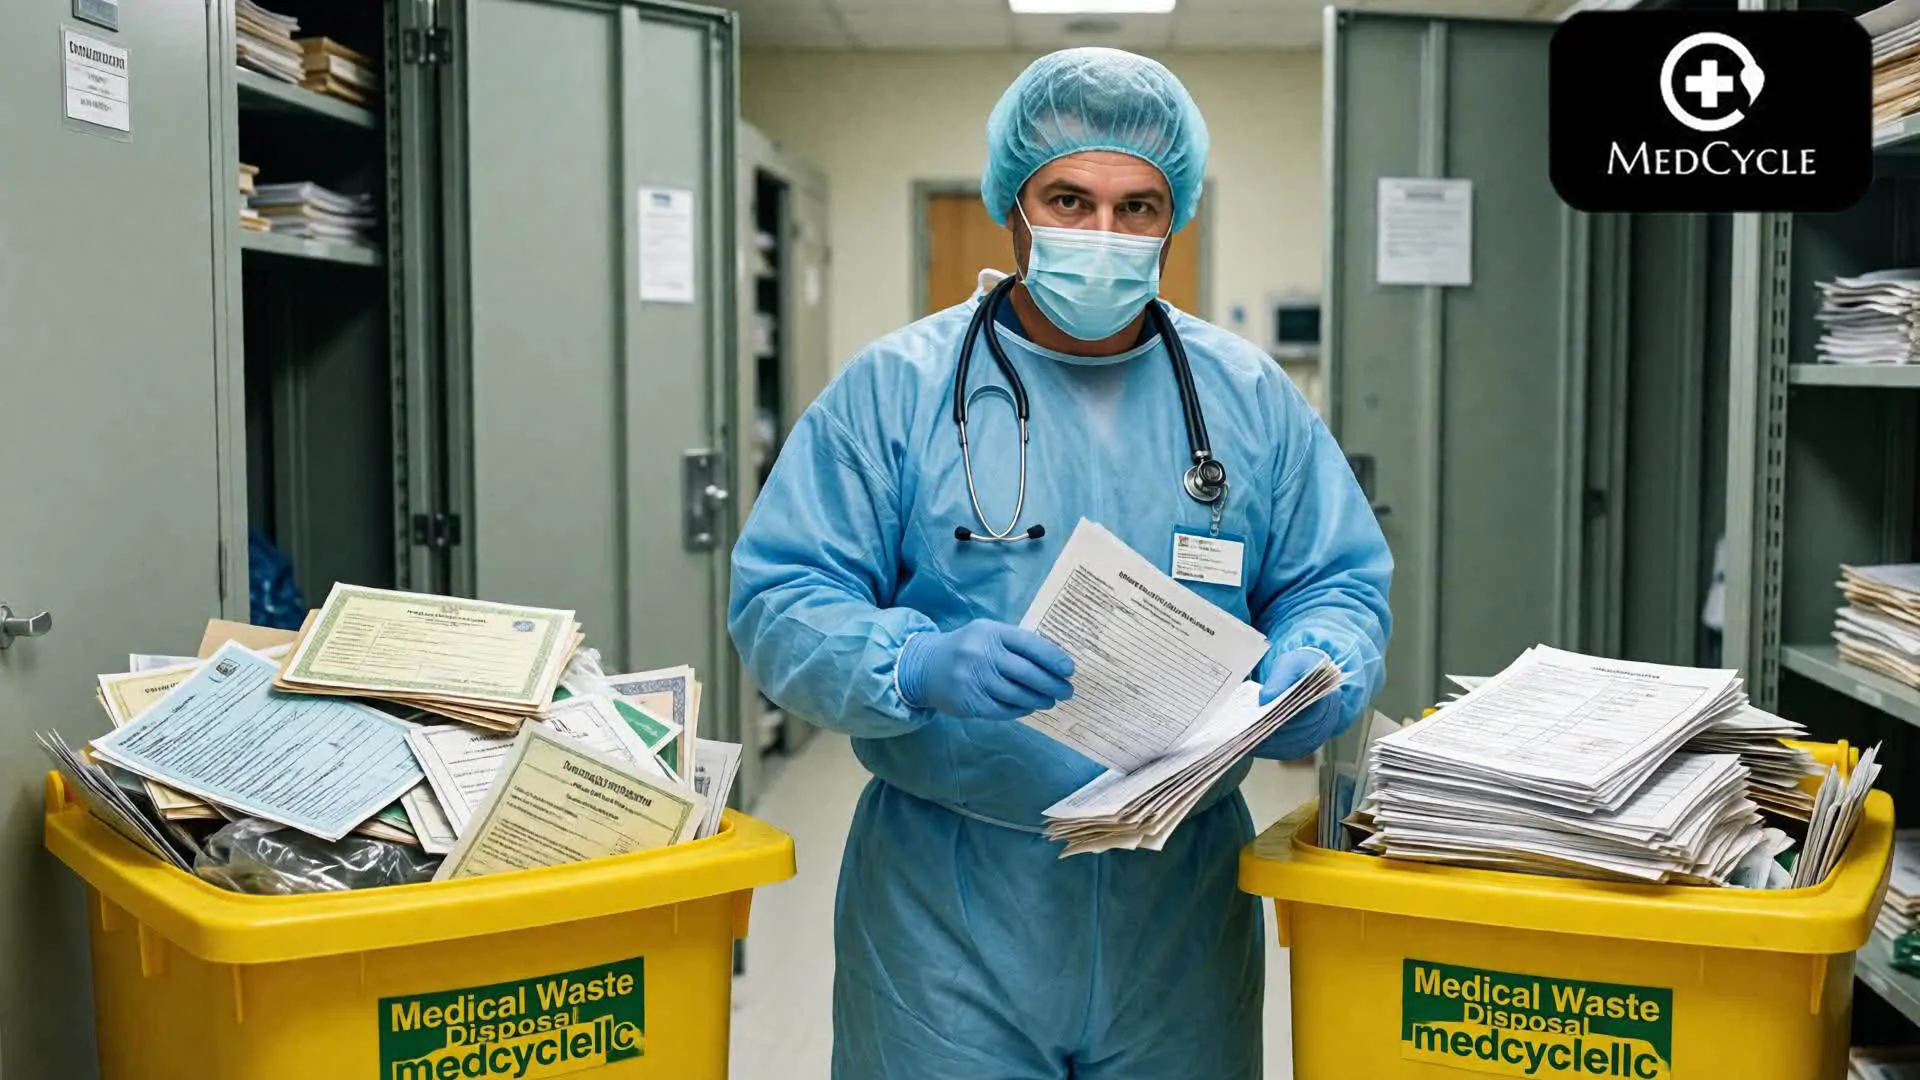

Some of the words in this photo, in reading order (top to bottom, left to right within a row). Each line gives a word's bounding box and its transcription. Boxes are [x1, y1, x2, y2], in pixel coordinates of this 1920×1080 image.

[391, 985, 526, 1032] Medical
[536, 971, 634, 1011] Waste
[1414, 966, 1540, 1010] Medical
[1551, 984, 1660, 1022] Waste
[1463, 1002, 1590, 1036] Disposal
[394, 1017, 636, 1080] medcyclellc
[447, 1006, 579, 1047] Disposal
[1414, 1023, 1659, 1080] medcyclellc
